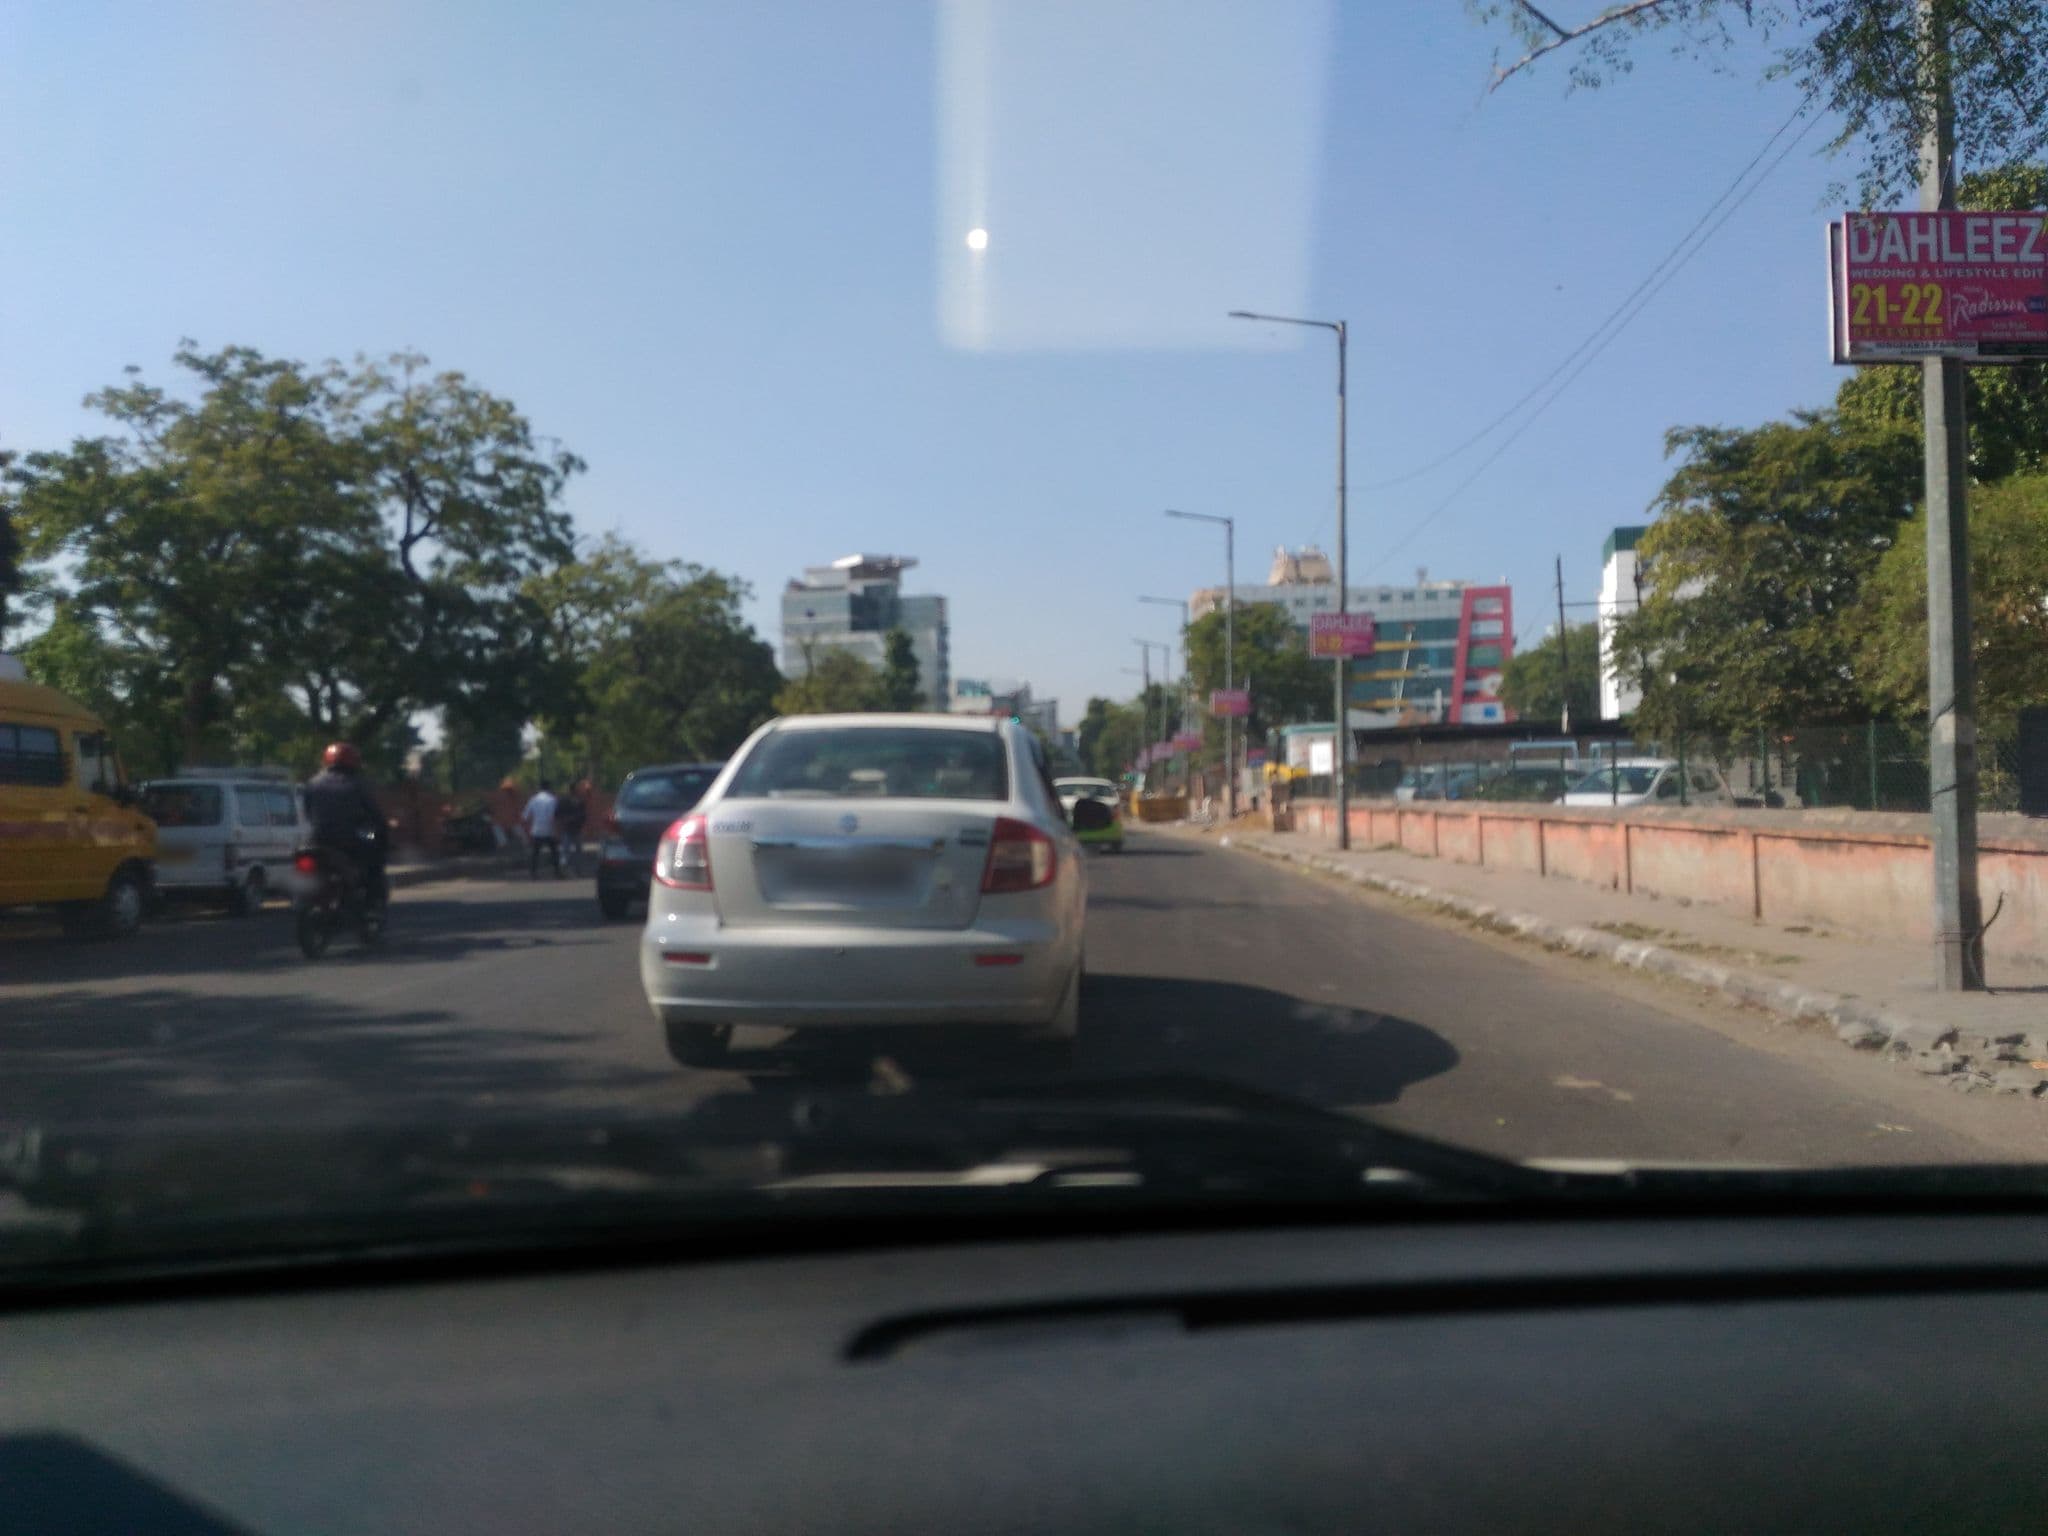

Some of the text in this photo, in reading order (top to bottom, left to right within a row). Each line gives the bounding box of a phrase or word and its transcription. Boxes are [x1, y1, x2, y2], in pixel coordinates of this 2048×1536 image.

[1850, 216, 2045, 264] DAHLEEZ
[1936, 268, 2008, 279] LIFESTYLE
[2013, 268, 2045, 279] EDIT
[1851, 283, 1944, 325] 21-22
